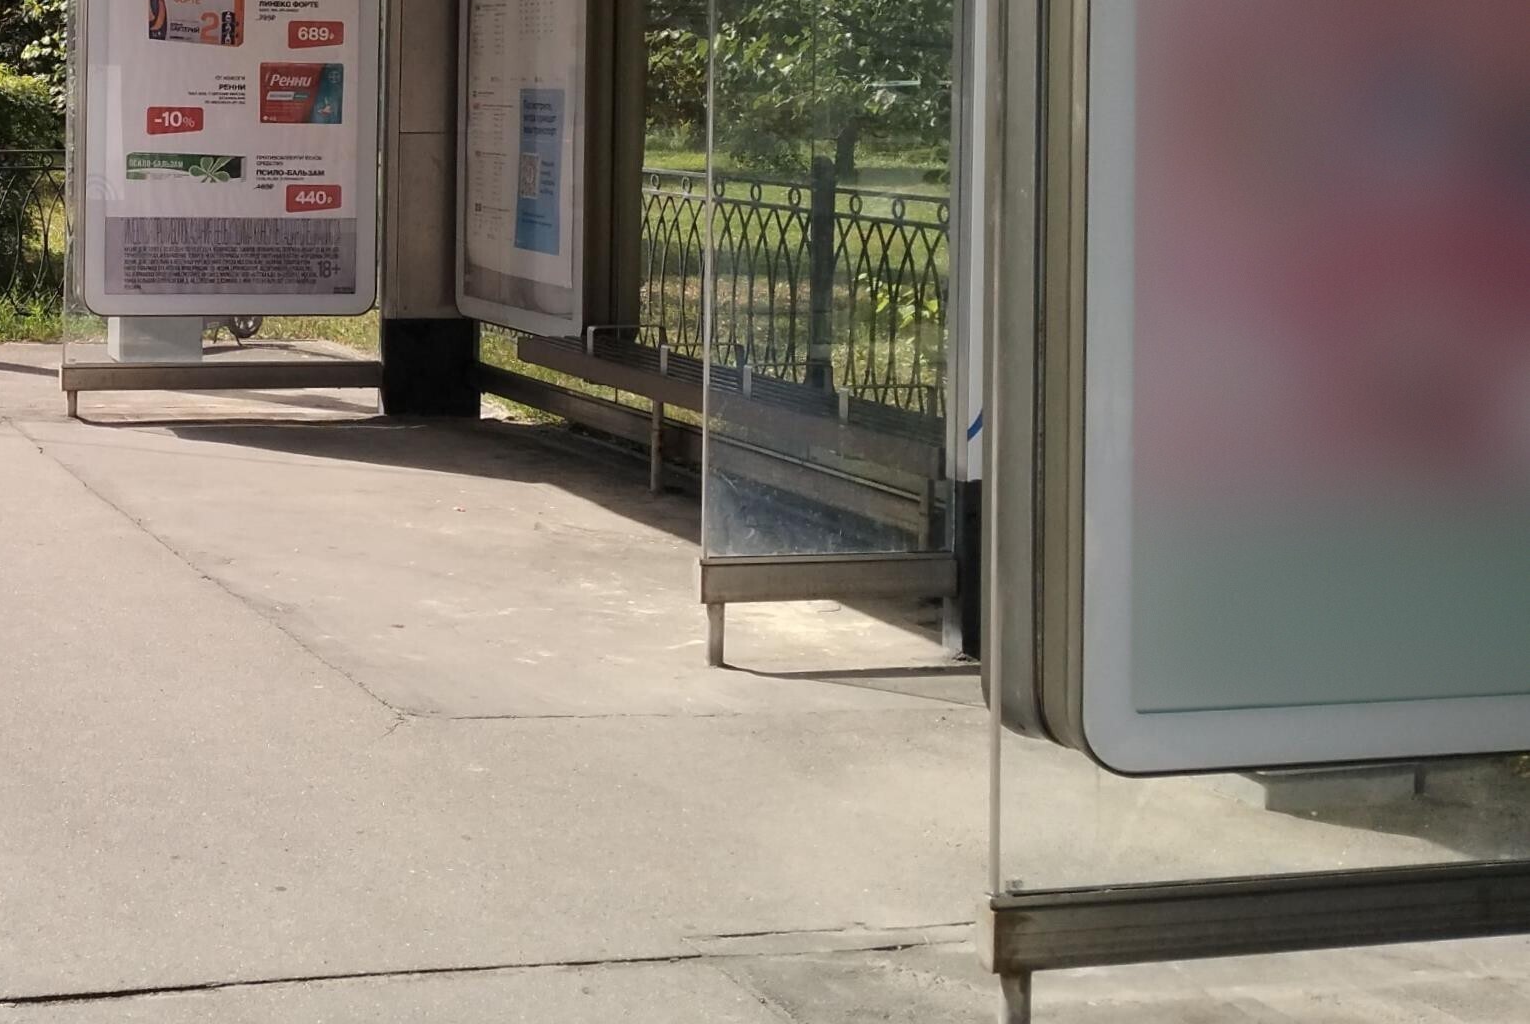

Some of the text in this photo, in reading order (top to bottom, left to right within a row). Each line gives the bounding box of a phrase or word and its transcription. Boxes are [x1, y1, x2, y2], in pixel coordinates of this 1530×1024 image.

[292, 1, 319, 9] ФОРТЕ
[200, 12, 219, 42] 2
[219, 83, 246, 91] РЕННИ
[270, 73, 312, 87] Ренни
[154, 111, 195, 127] -10%
[256, 169, 325, 177] ПСИЛО-БАЛЬЗАМ
[318, 260, 341, 279] 18+
